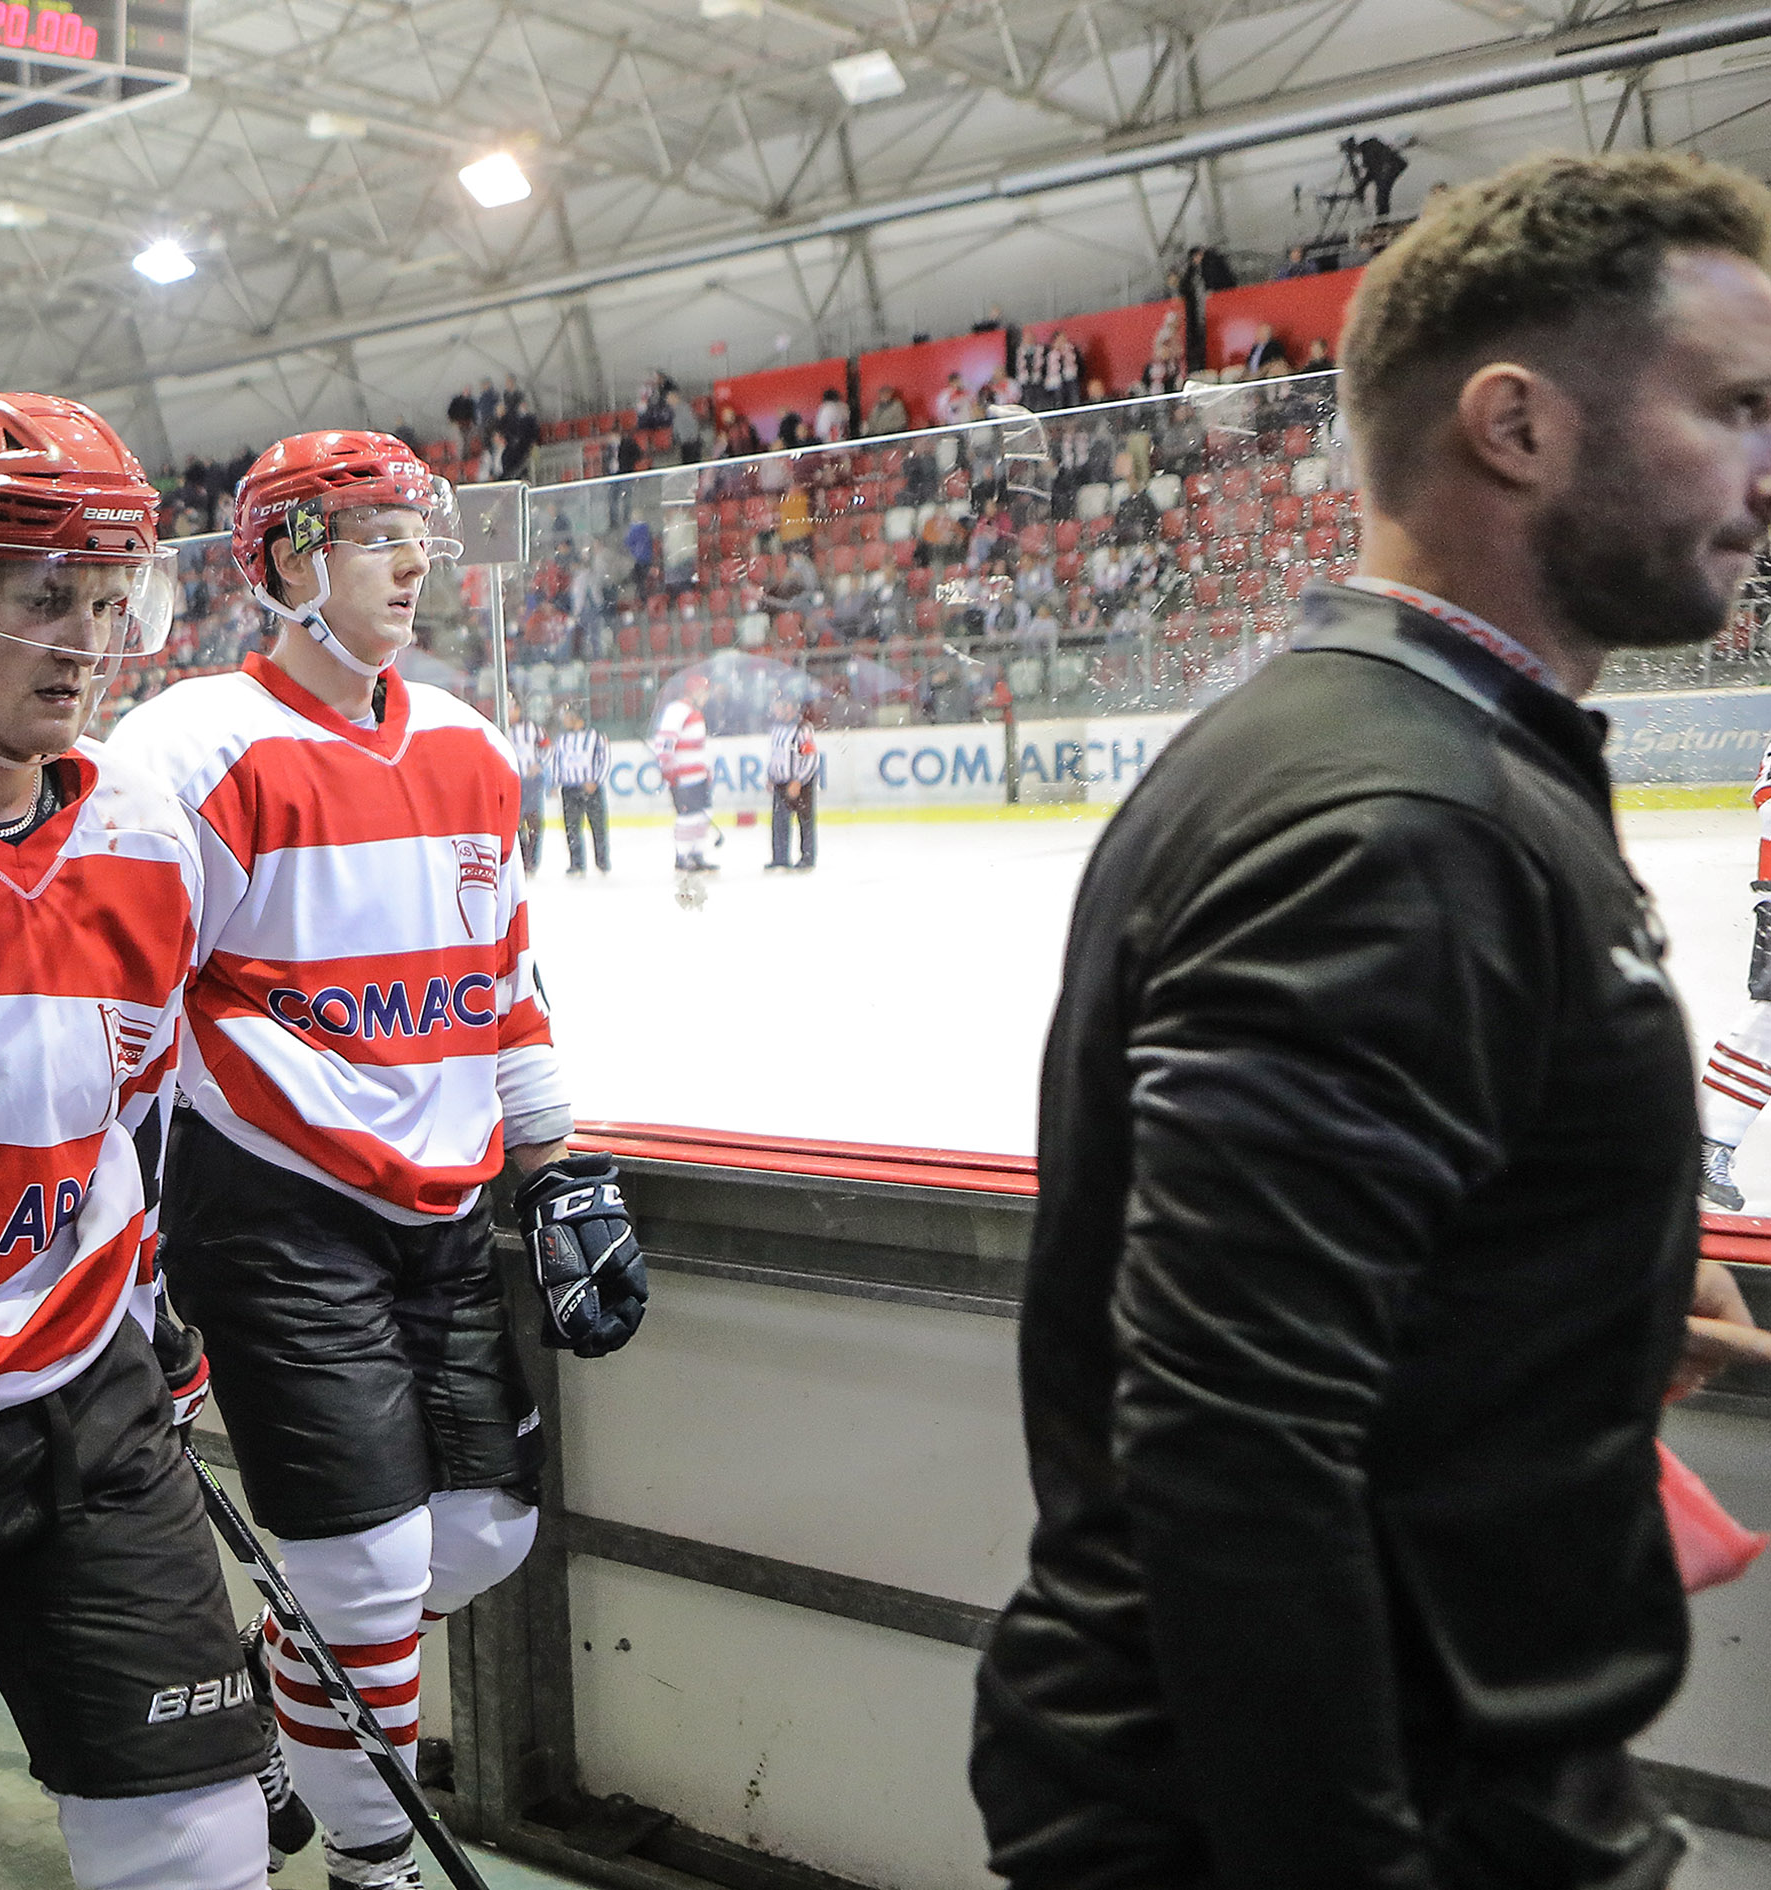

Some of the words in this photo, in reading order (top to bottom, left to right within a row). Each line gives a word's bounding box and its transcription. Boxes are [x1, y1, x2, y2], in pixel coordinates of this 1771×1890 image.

[83, 507, 145, 522] BAUER
[259, 497, 300, 517] CCM
[879, 738, 1145, 787] COMARCH
